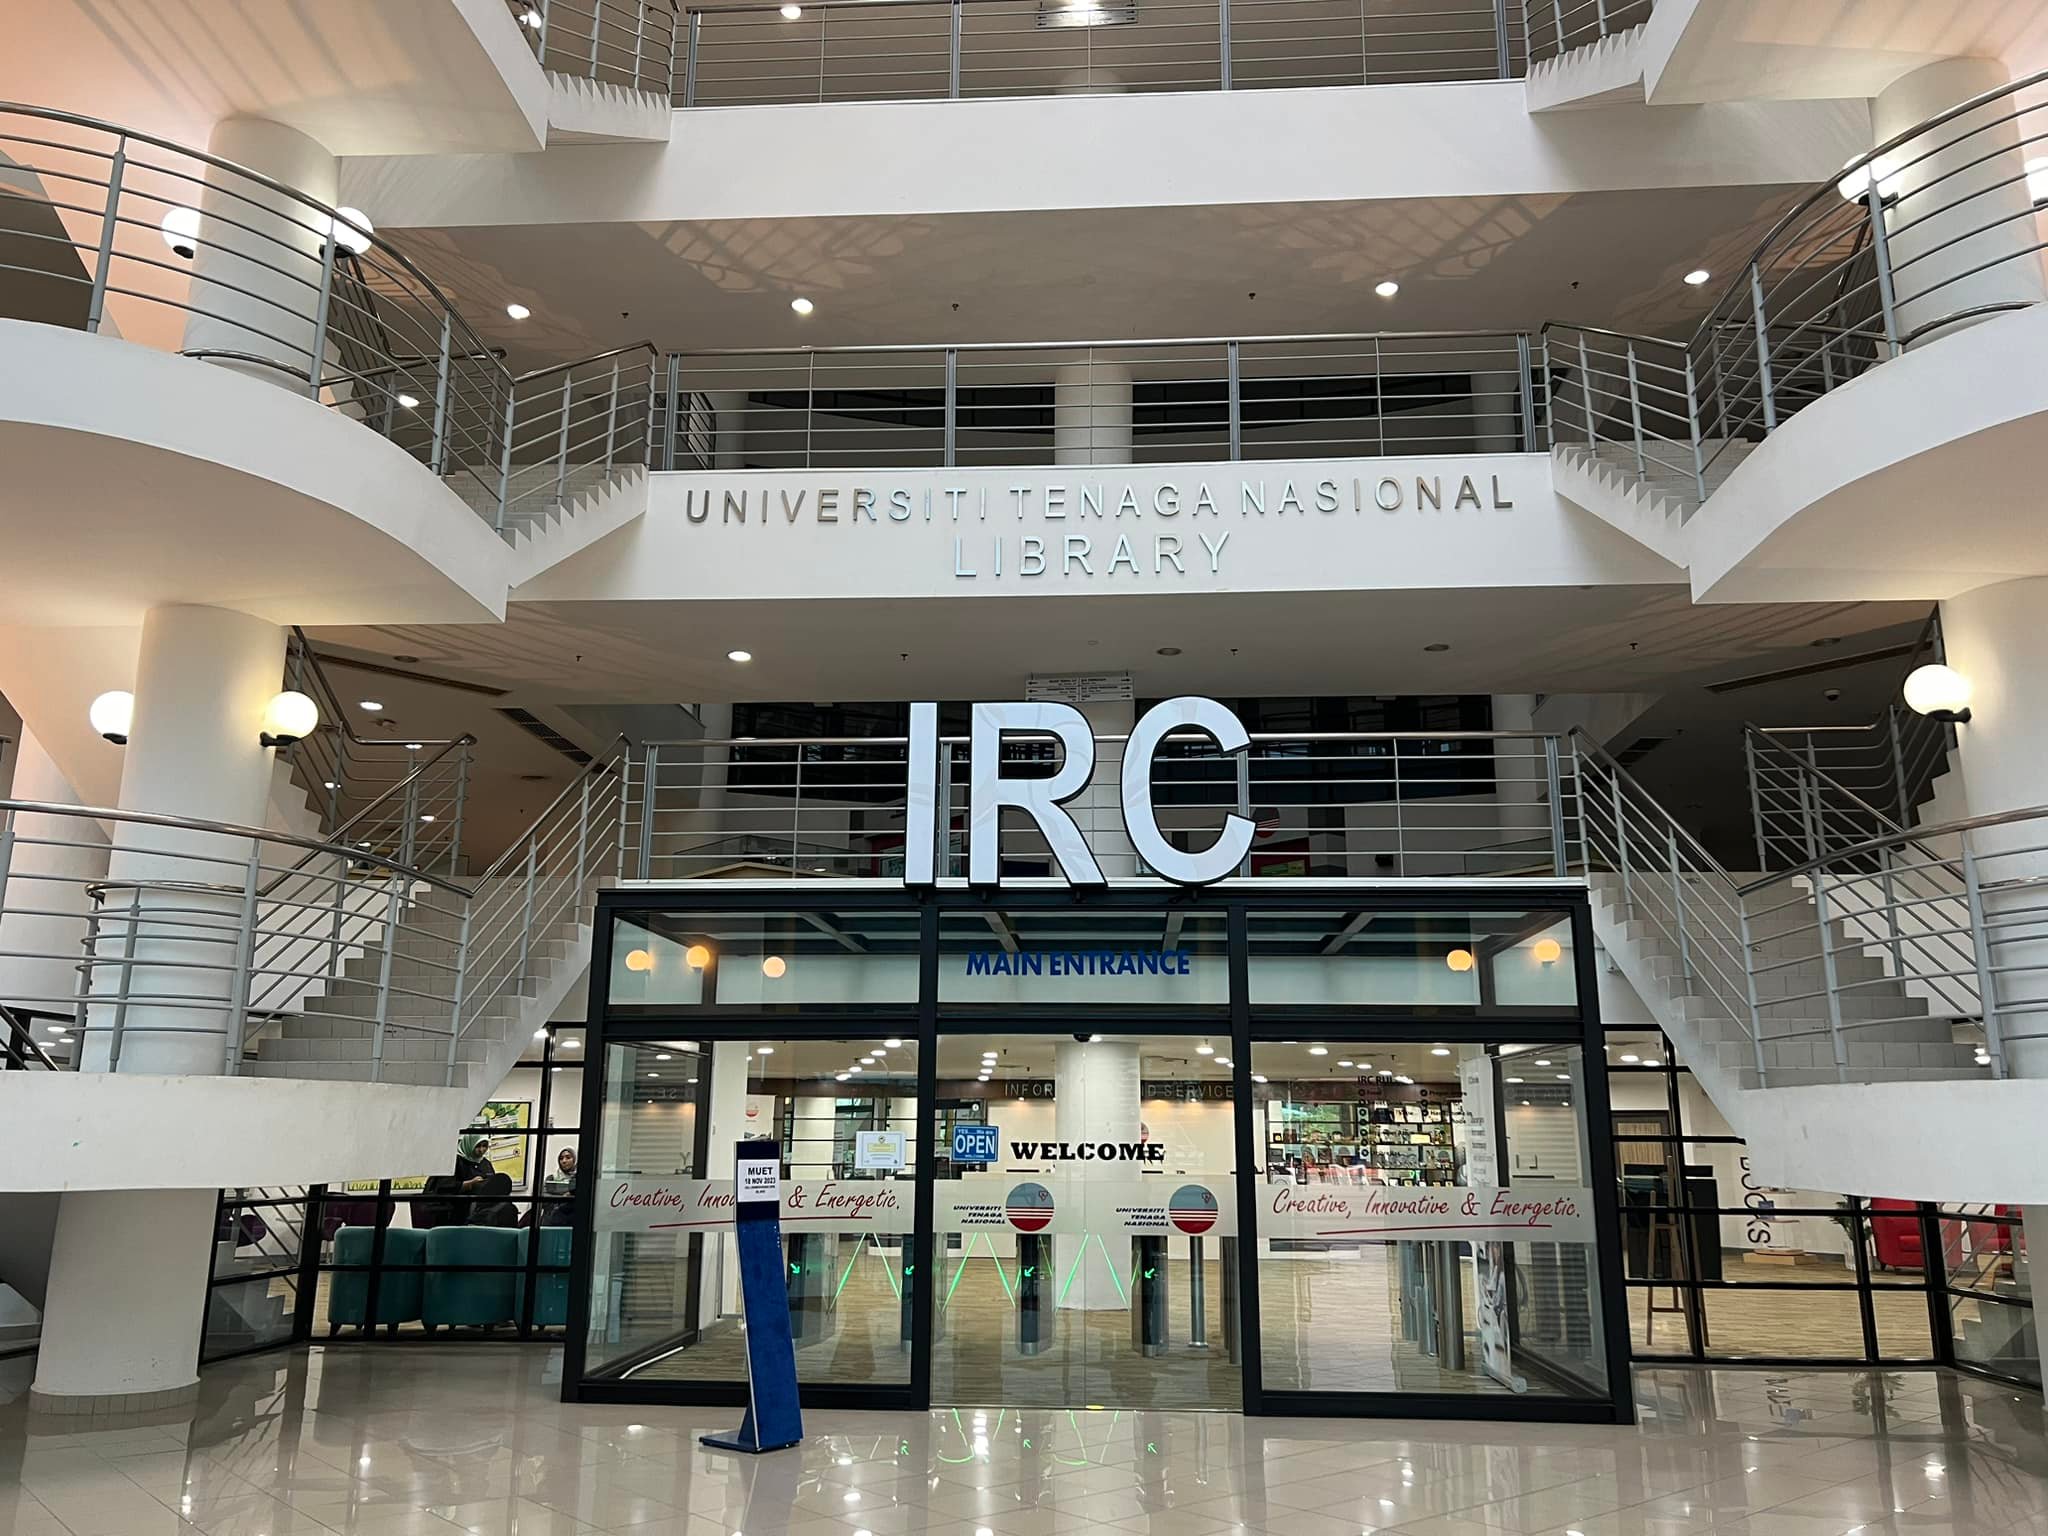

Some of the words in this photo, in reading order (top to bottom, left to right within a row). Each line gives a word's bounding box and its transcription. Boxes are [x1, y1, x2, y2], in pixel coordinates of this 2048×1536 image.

[687, 487, 985, 523] UNIVERSITI
[1009, 482, 1218, 519] TENAGA
[1241, 475, 1513, 514] NASIONAL
[955, 531, 1230, 577] LIBRARY
[905, 695, 1256, 888] IRC
[966, 951, 1042, 976] MAIN
[1049, 950, 1190, 976] ENTRANCE
[1004, 1083, 1054, 1097] INFOR
[955, 1134, 995, 1154] OPEN
[1010, 1142, 1165, 1161] WELCOME
[748, 1166, 773, 1175] MUET
[610, 1183, 686, 1212] Creative,
[788, 1186, 807, 1208] &
[815, 1184, 900, 1217] Energetic.
[1272, 1188, 1352, 1219] Creative,
[1365, 1190, 1449, 1215] Innovative
[1461, 1192, 1481, 1216] &
[1490, 1190, 1581, 1225] Energetic.
